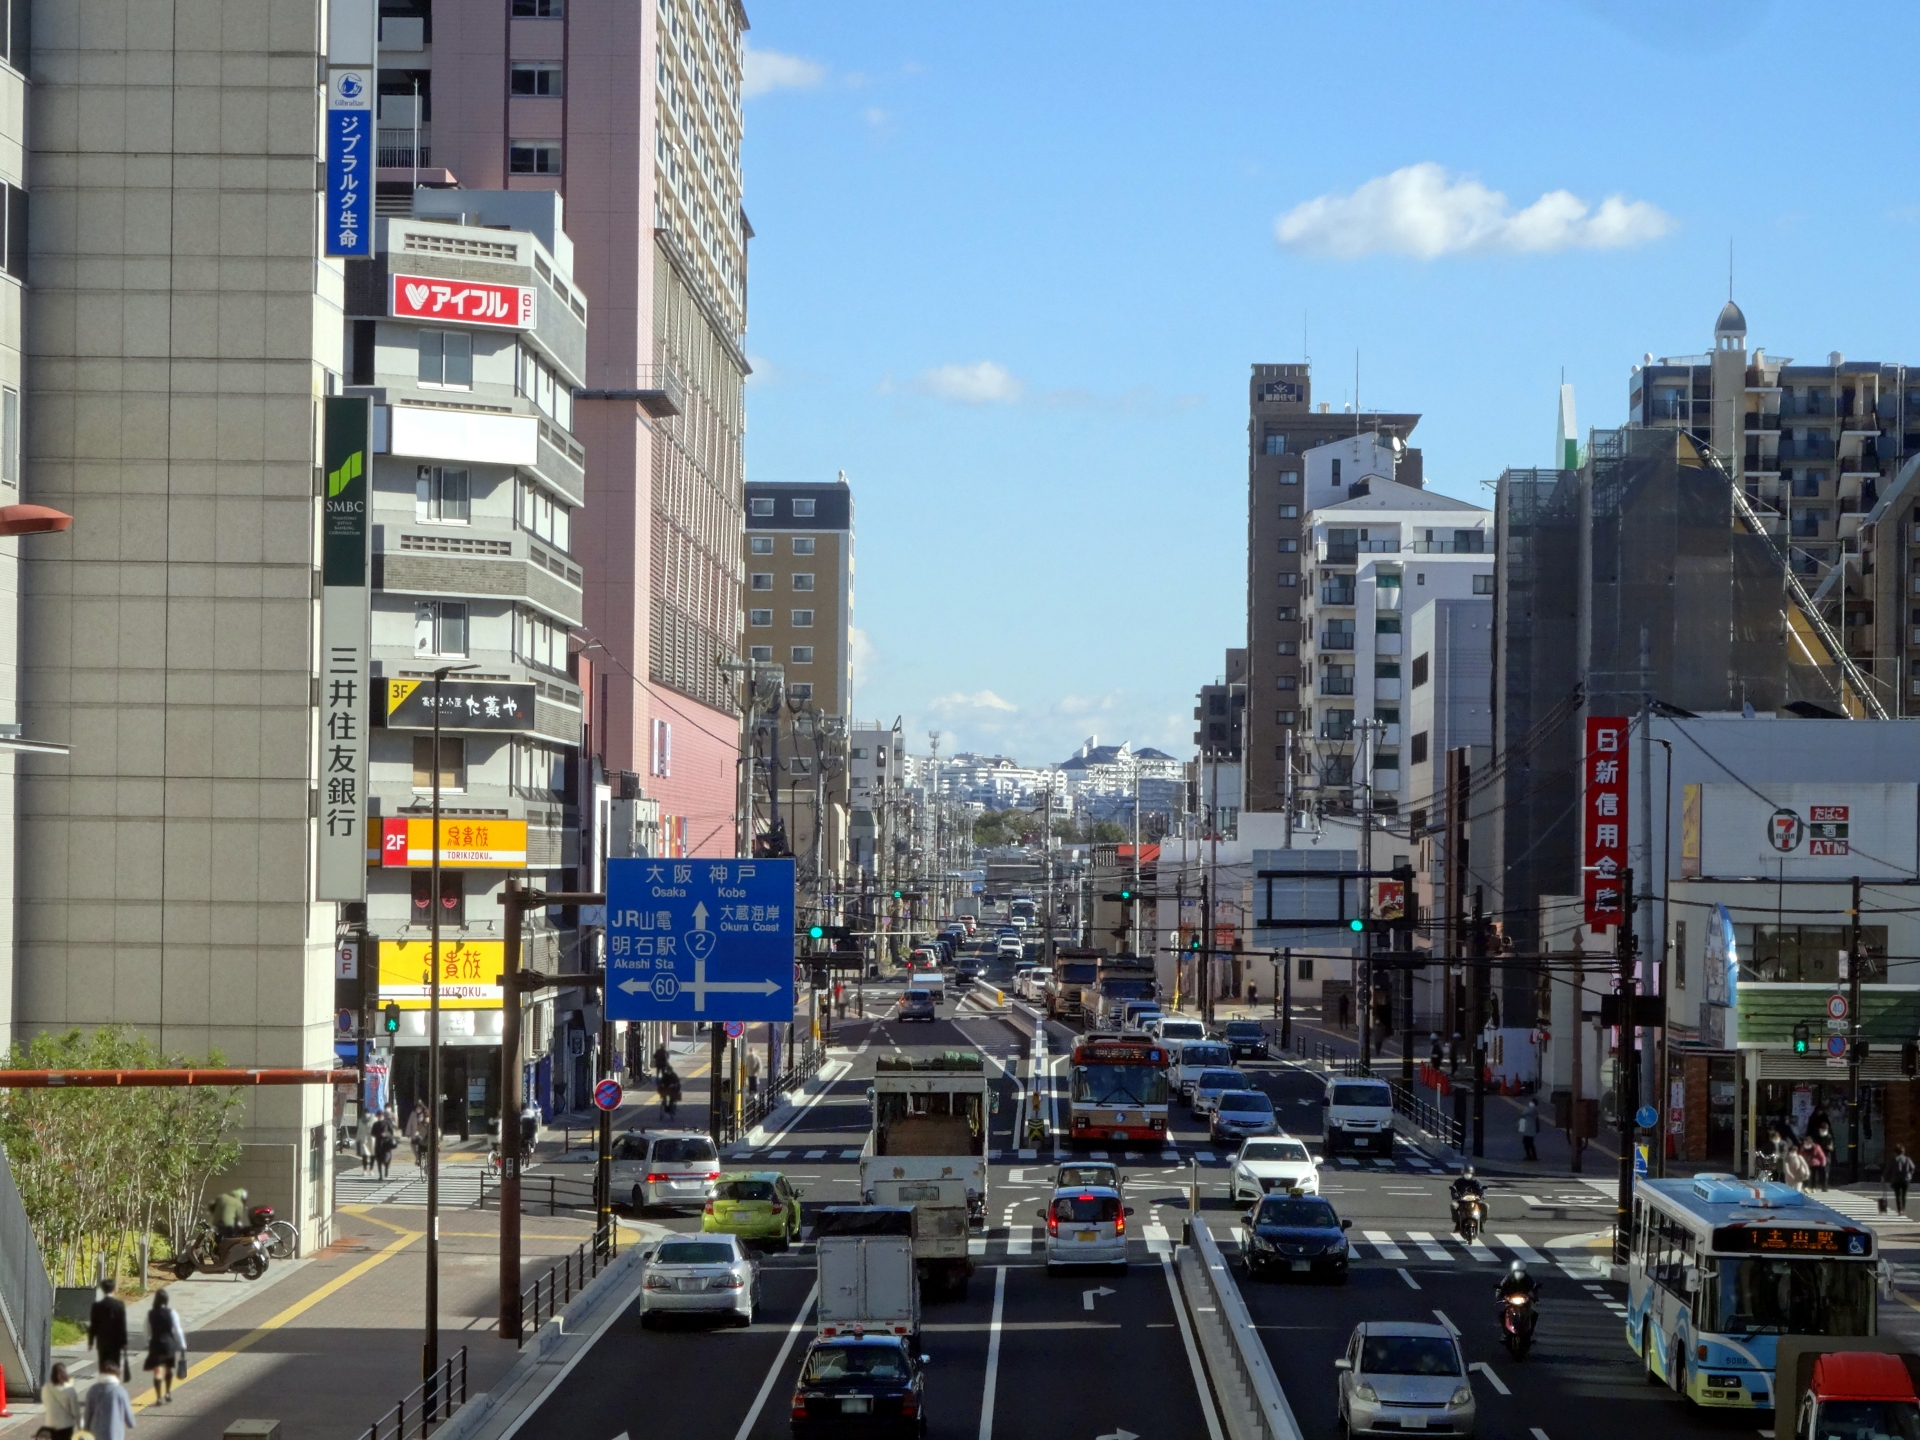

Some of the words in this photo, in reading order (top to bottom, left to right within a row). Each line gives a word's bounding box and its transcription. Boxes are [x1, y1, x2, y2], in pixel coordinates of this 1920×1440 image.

[339, 116, 360, 248] ジブラルタ生命
[431, 286, 509, 319] アイフル
[326, 500, 364, 513] SMBC
[392, 684, 408, 699] 3F
[326, 646, 358, 837] 三井住友銀行
[1814, 807, 1845, 820] たばこ
[447, 825, 489, 847] 鳥貴族
[1822, 824, 1837, 837] 酒
[386, 834, 406, 850] 2F
[1813, 841, 1846, 854] ATM
[447, 851, 489, 860] TORIKIZOKU
[645, 864, 693, 884] 大阪
[709, 864, 756, 884] 神戸
[651, 886, 686, 898] Osaka
[718, 887, 747, 898] Kobe
[612, 909, 672, 931] JR山電
[720, 904, 780, 922] 大蔵海岸
[720, 922, 748, 932] Okura
[752, 922, 780, 932] Coast
[612, 936, 677, 956] 明石駅
[695, 933, 706, 951] 2
[341, 948, 352, 975] 6F
[614, 958, 650, 969] Akashi
[655, 979, 675, 996] 60
[1832, 1001, 1844, 1013] 40
